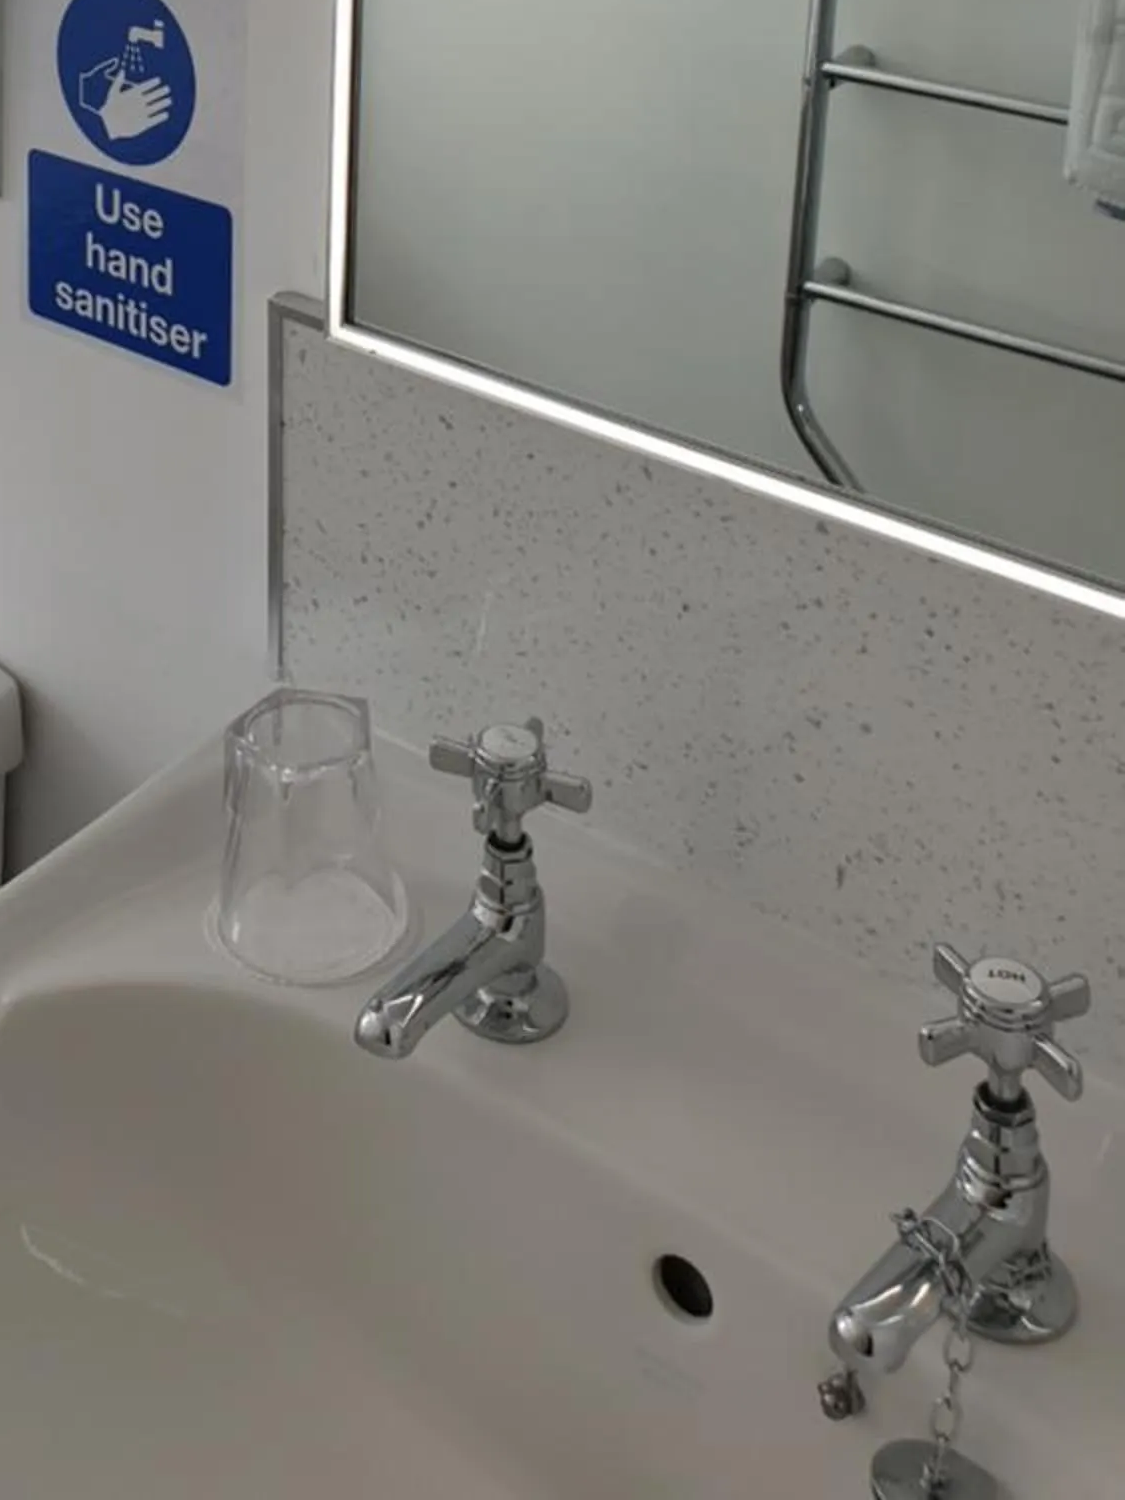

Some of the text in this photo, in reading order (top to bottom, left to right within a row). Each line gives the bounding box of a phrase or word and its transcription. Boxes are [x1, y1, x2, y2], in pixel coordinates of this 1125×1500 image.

[95, 182, 164, 239] Use
[86, 231, 173, 296] hand
[54, 280, 208, 360] sanitiser
